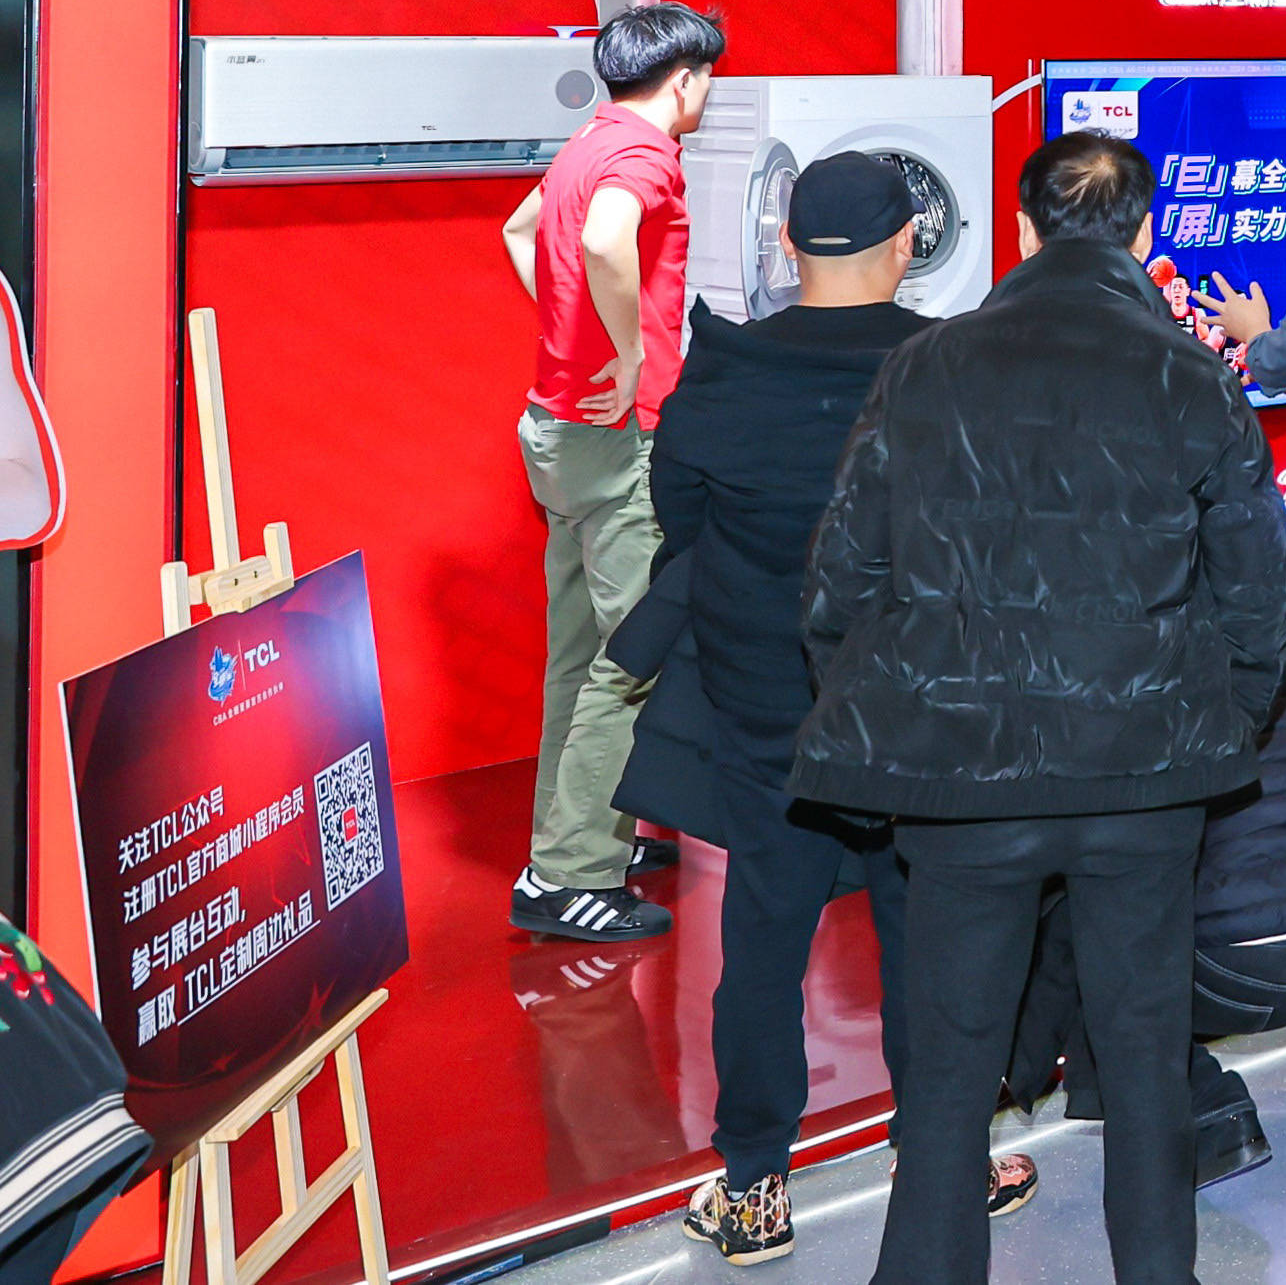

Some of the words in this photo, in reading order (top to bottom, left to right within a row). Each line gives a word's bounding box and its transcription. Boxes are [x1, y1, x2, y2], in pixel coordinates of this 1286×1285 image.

[1103, 106, 1133, 116] TCL
[244, 639, 280, 672] TCL
[118, 785, 224, 875] 关注TCL公众号
[124, 785, 305, 924] 注册TCL官方商城小程序会员
[138, 984, 177, 1047] 赢取
[184, 890, 313, 1011] TCL定制周边礼品
